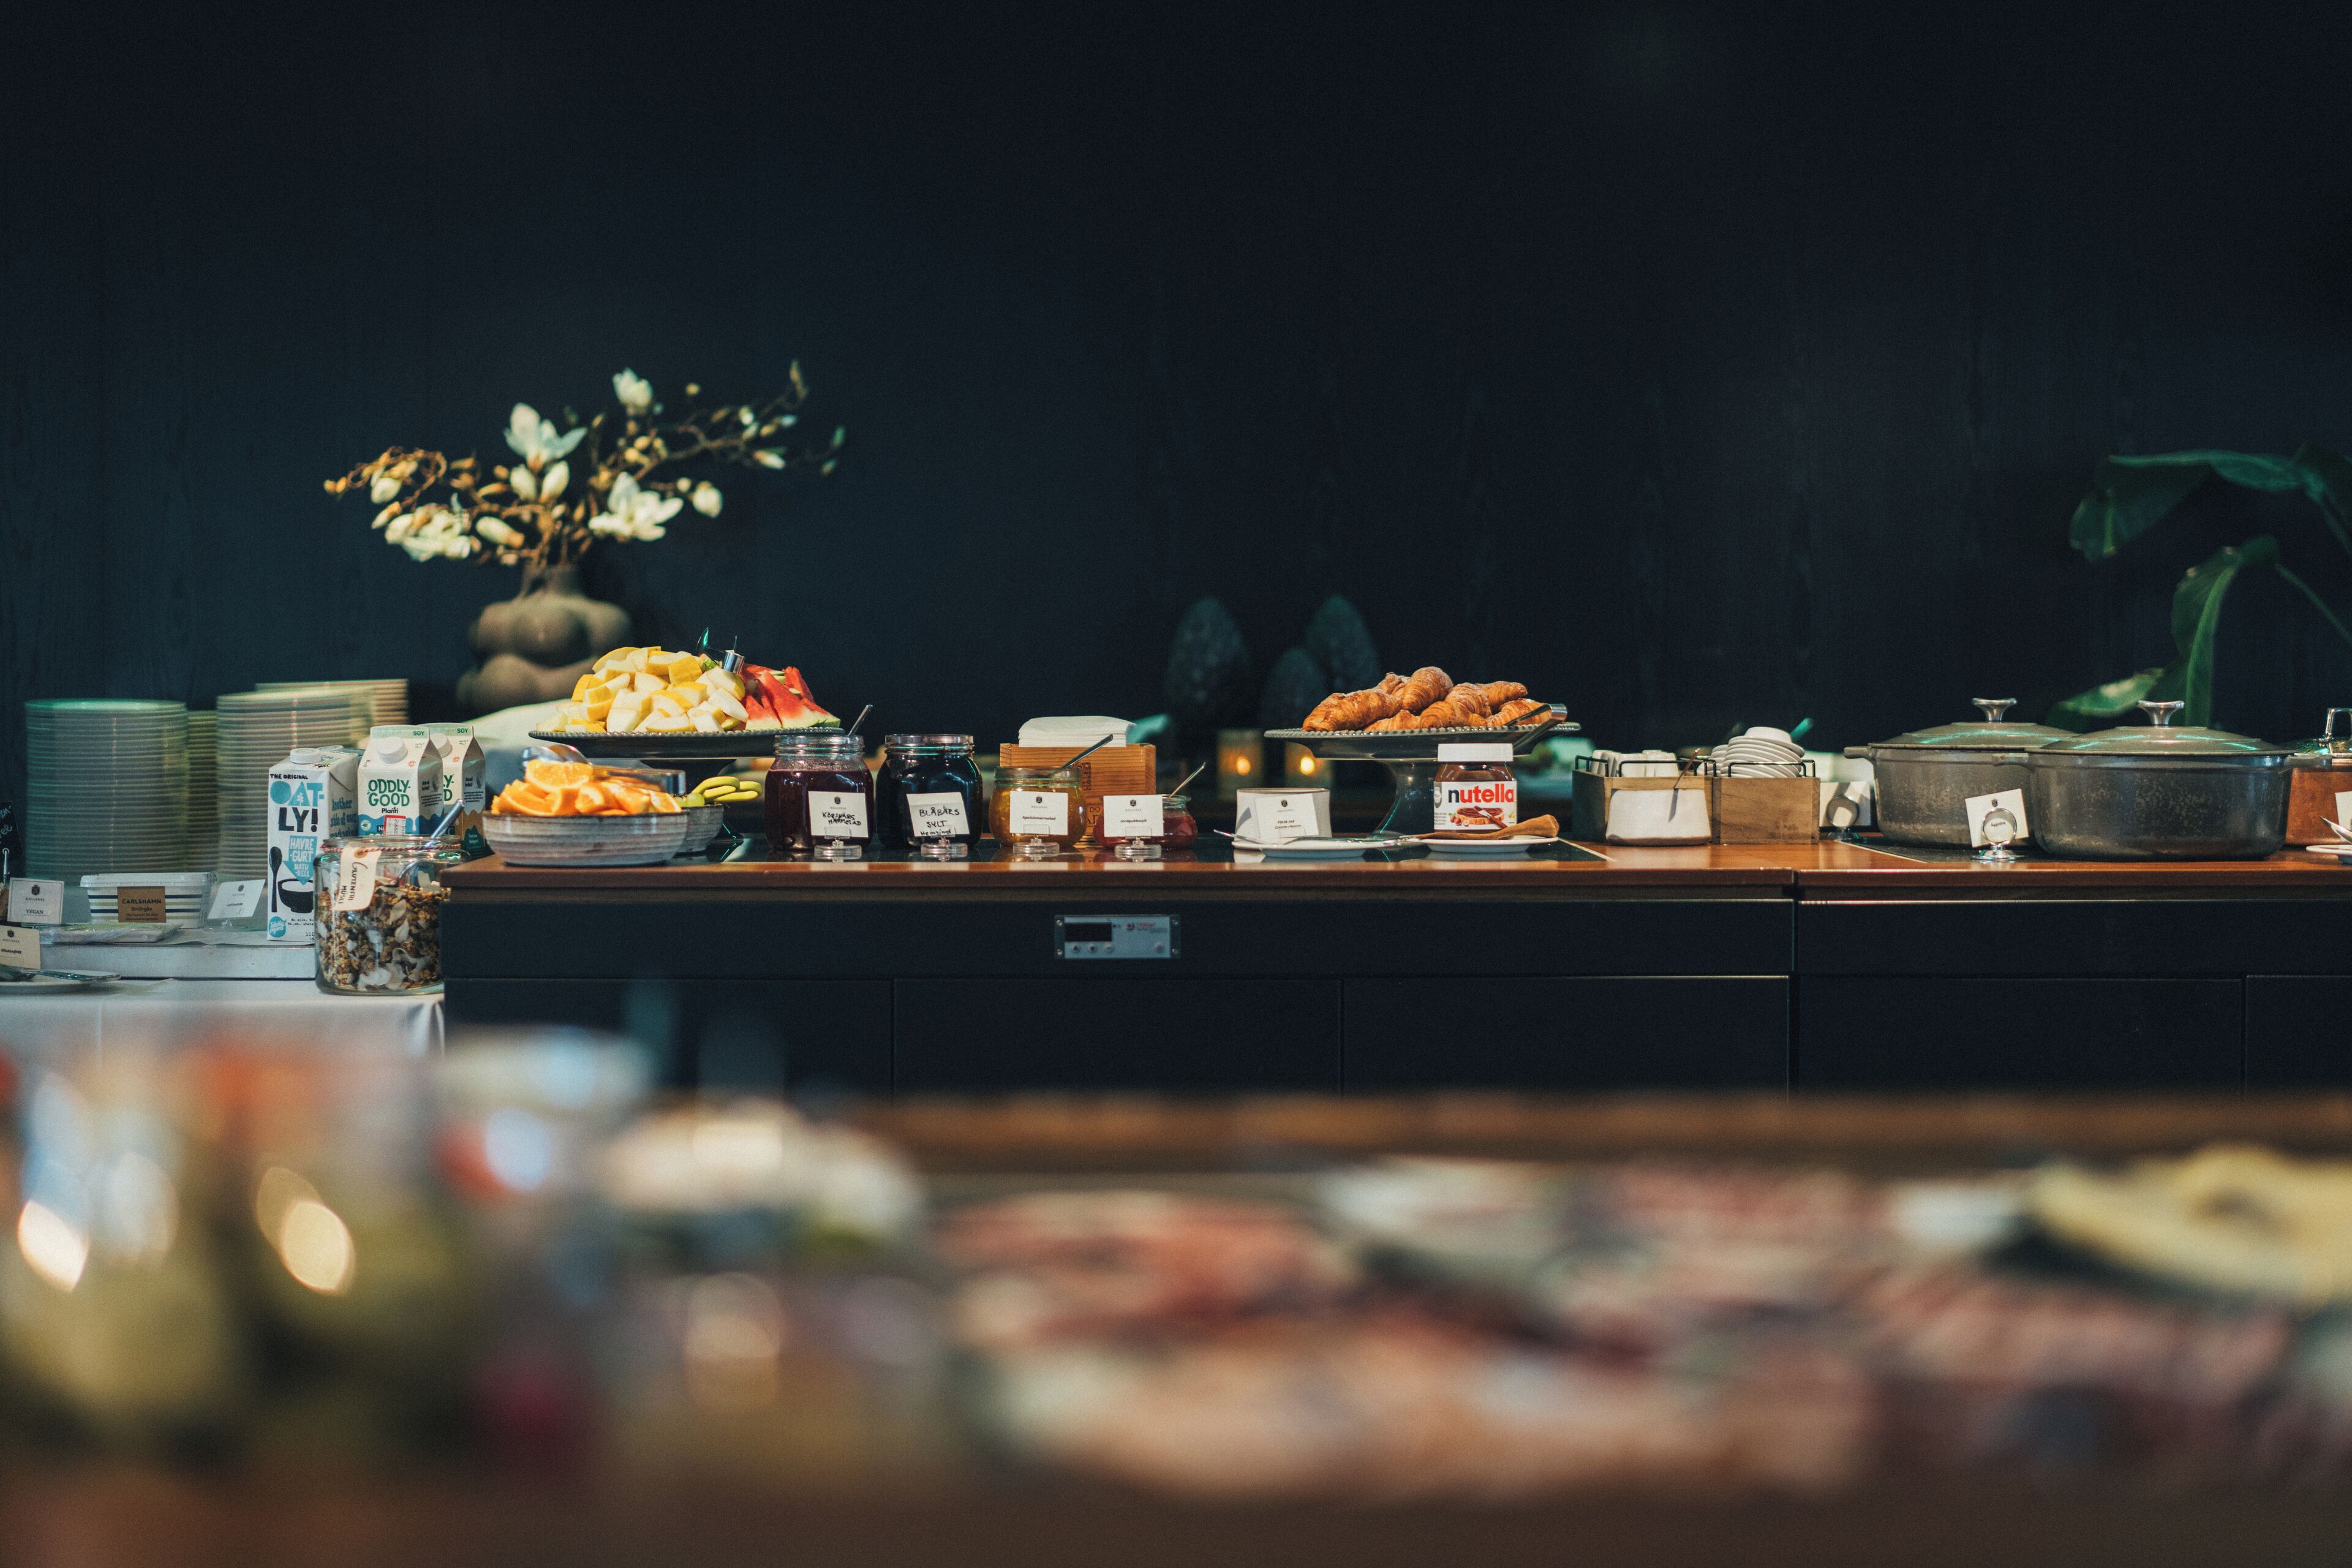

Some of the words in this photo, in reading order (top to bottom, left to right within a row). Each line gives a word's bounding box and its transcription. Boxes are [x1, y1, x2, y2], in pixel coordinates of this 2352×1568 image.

[270, 780, 325, 807] OAT-
[368, 778, 410, 794] ODDLY-
[1448, 783, 1514, 803] nutella
[368, 793, 410, 807] GOOD
[278, 807, 318, 832] LY!
[919, 805, 960, 816] BLÅBÄRS
